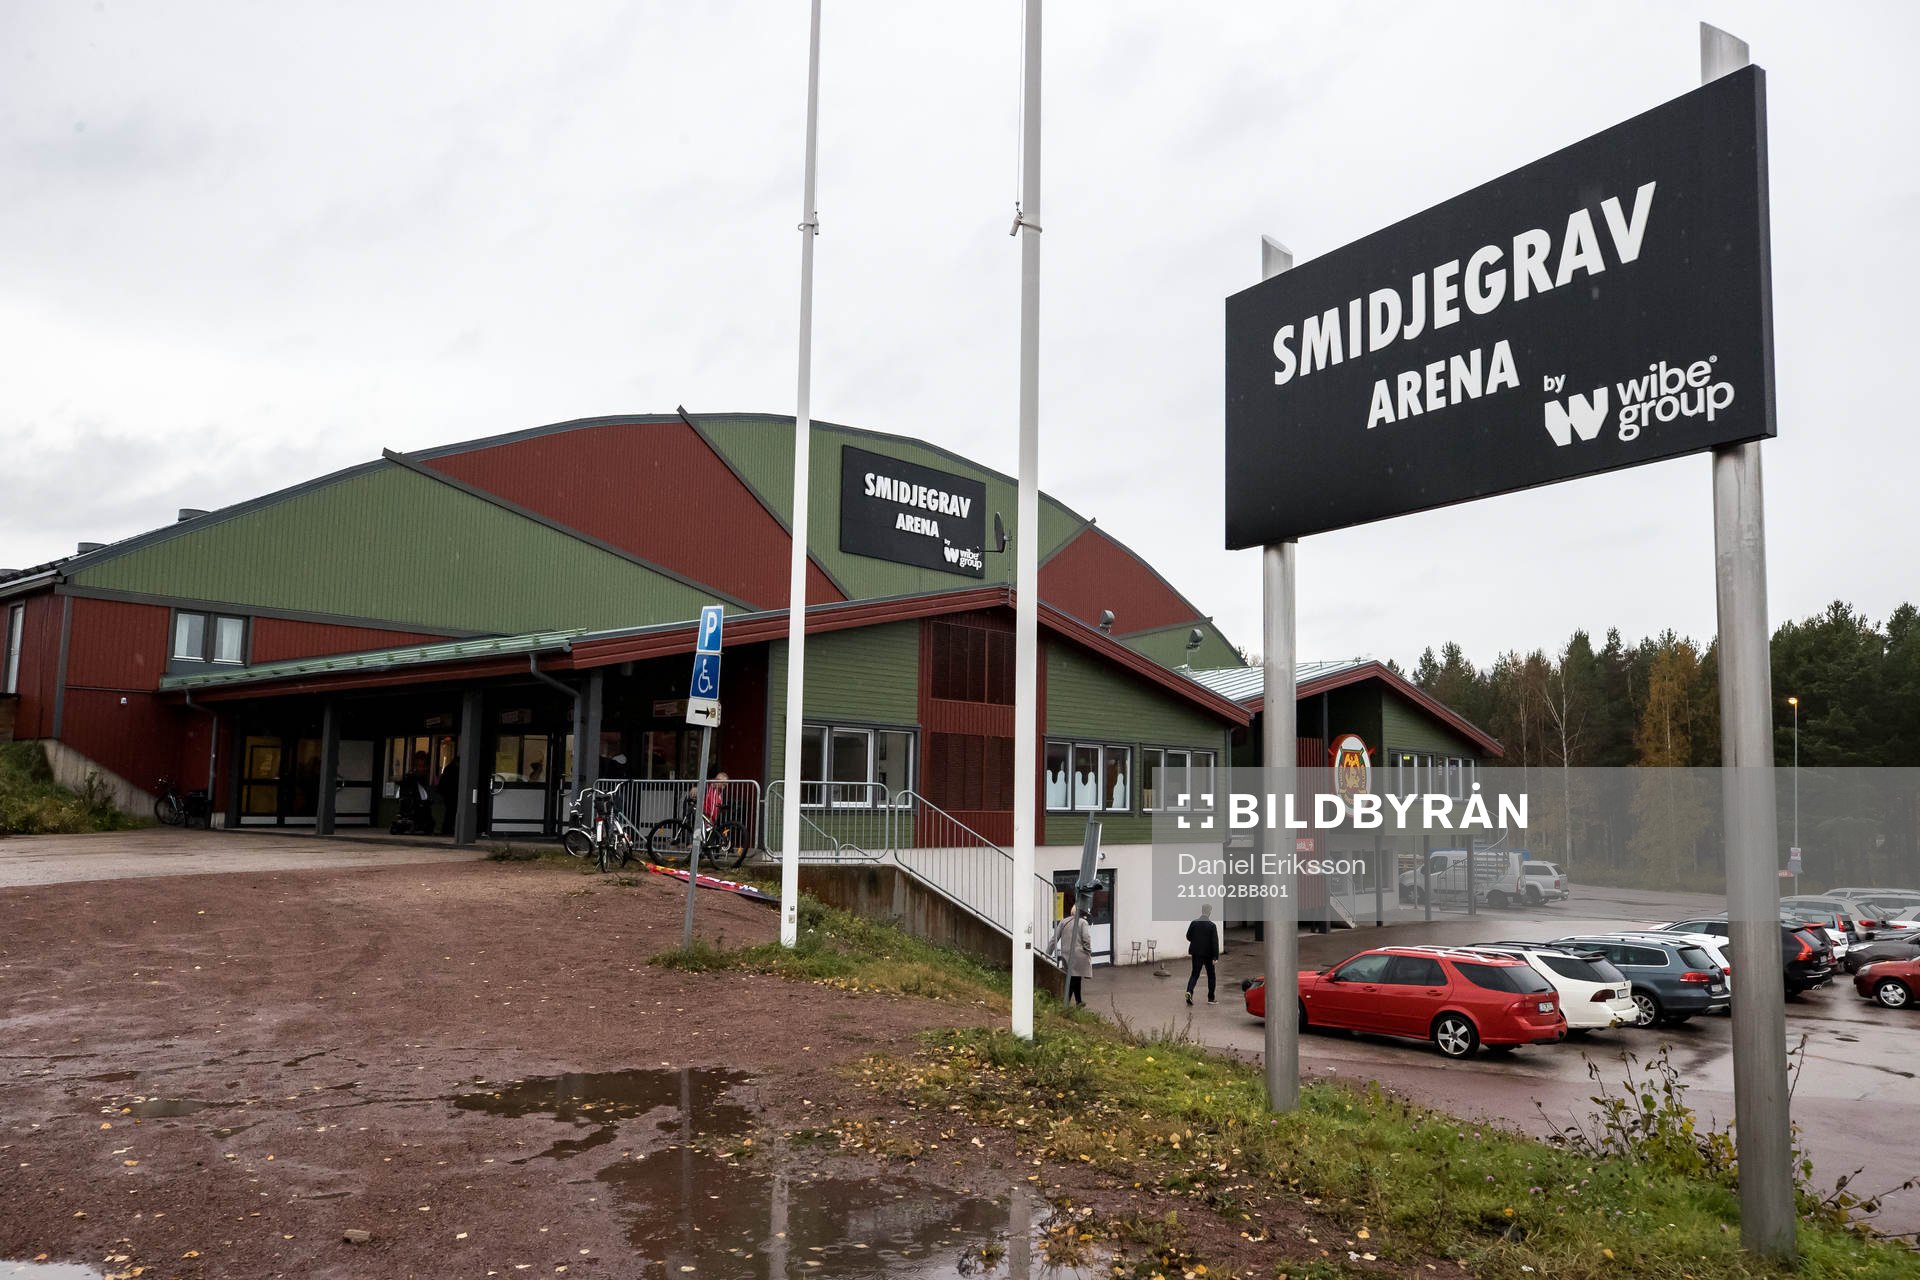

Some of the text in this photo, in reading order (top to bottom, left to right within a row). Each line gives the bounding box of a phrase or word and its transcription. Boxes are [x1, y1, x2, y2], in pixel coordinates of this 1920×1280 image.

[1273, 181, 1657, 385] SMIDJEGRAV
[1367, 339, 1520, 429] ARENA
[1543, 375, 1565, 394] by
[1618, 382, 1735, 442] group
[865, 473, 971, 518] SMIDJEGRAV
[895, 513, 940, 538] ARENA
[959, 556, 983, 570] group
[704, 611, 718, 648] P
